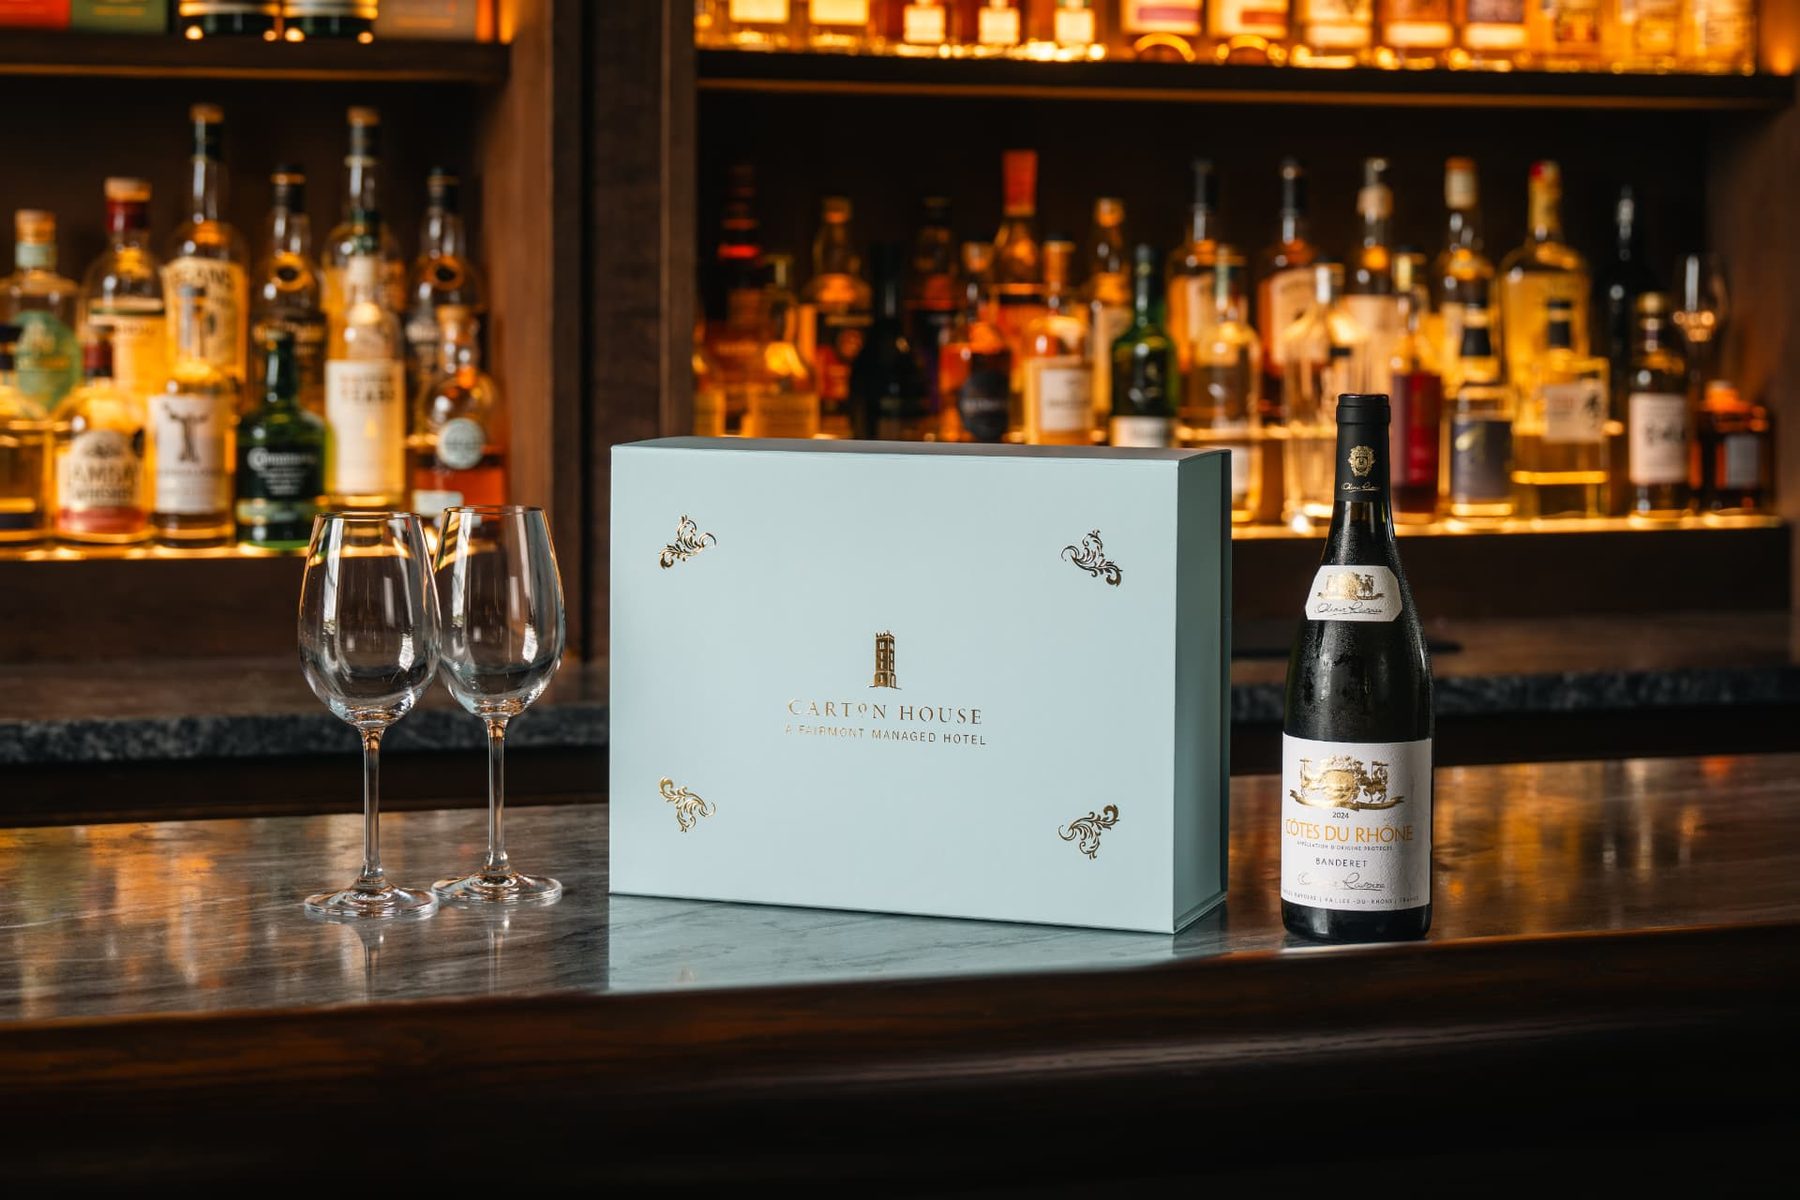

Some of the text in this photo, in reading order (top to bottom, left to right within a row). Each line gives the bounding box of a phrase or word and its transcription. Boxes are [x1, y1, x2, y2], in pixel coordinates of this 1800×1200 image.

[788, 698, 983, 725] CARTON HOUSE
[785, 724, 986, 746] A FAIRMONT MANAGED HOTEL
[1332, 811, 1349, 820] 2024
[1286, 819, 1413, 843] CÔTES DU RHÔNE
[1315, 857, 1368, 868] BANDERET
